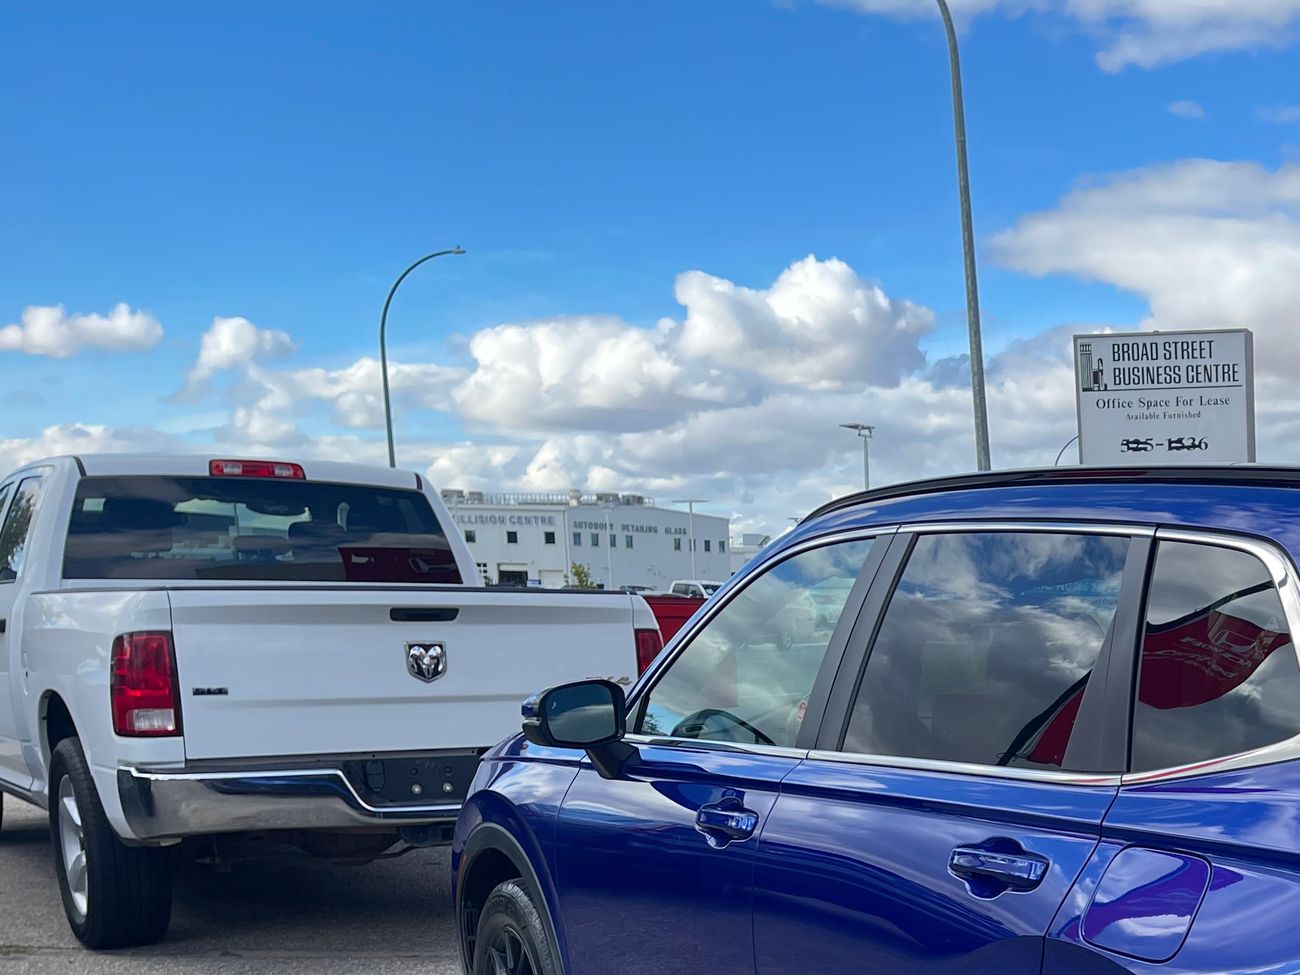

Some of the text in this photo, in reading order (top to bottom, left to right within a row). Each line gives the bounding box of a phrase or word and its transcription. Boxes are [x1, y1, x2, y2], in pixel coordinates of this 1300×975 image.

[1111, 340, 1214, 362] BROAD STREET
[1113, 363, 1240, 386] BUSINESS CENTRE
[1096, 395, 1231, 410] Office Space For Lease
[1125, 411, 1201, 421] Available Furnished
[508, 514, 556, 526] CENTRE
[621, 523, 658, 534] DETAILING
[664, 526, 687, 535] GLASS
